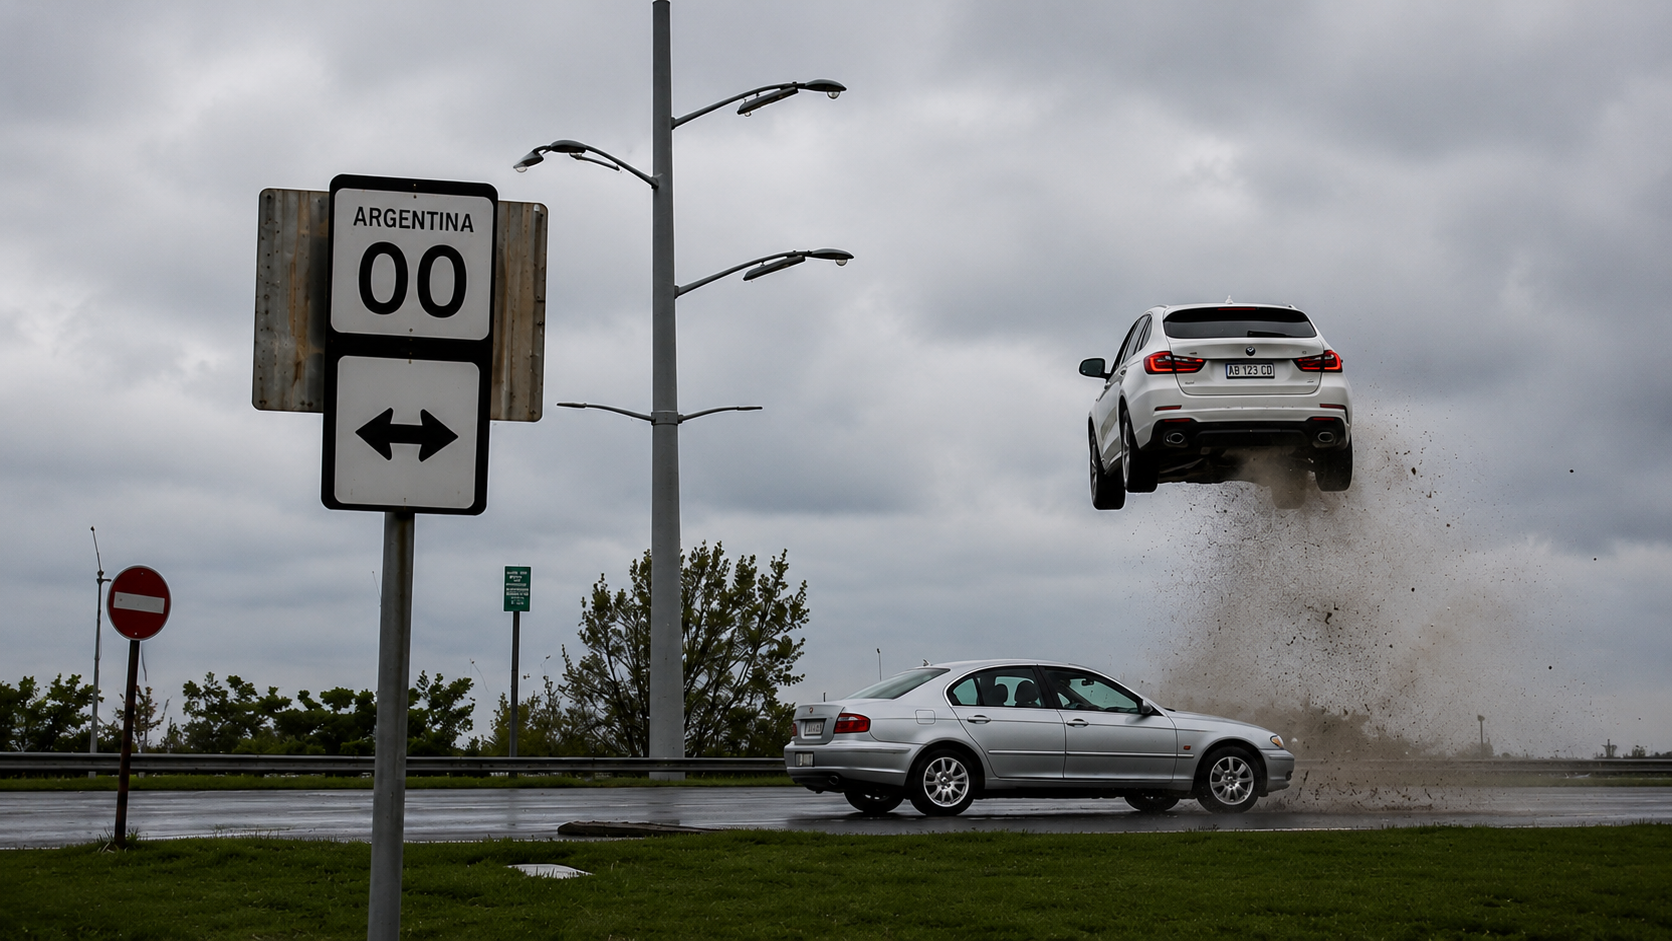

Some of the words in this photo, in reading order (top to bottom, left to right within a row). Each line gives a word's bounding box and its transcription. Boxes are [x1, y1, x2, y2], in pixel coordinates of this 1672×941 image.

[353, 206, 474, 233] ARGENTINA
[358, 241, 467, 319] 00
[1228, 365, 1240, 375] AB
[1242, 365, 1258, 375] 123
[1261, 365, 1273, 375] CD
